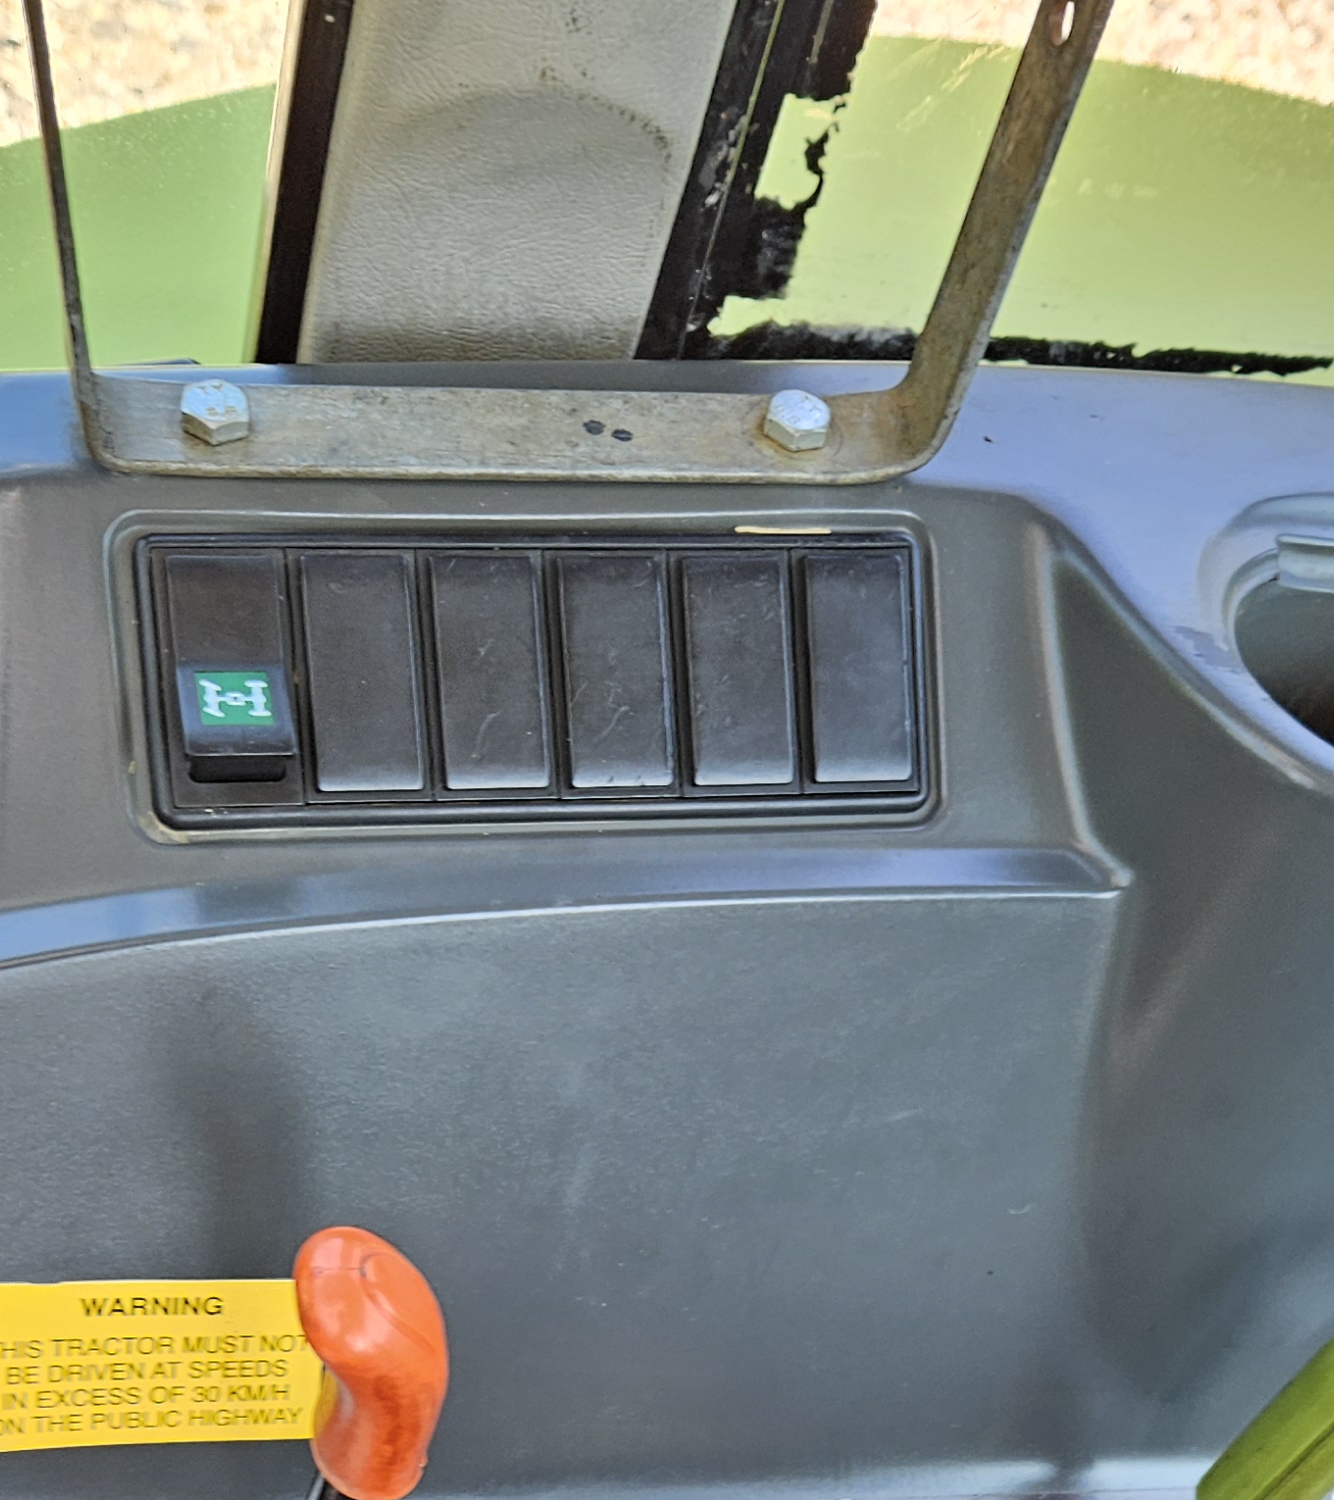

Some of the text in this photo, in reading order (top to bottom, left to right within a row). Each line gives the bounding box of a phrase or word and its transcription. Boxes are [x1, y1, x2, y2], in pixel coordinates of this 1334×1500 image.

[80, 1296, 224, 1317] WARNING
[50, 1336, 174, 1358] TRACTOR
[183, 1335, 255, 1354] MUST
[260, 1334, 308, 1353] NOT
[6, 1359, 289, 1385] BE DRIVEN AT SPEEDS
[1, 1392, 28, 1411] IN
[36, 1387, 142, 1409] EXCESS
[149, 1385, 186, 1404] OF
[190, 1385, 221, 1403] 30
[31, 1413, 84, 1434] THE
[90, 1410, 182, 1431] PUBLIC
[187, 1407, 304, 1427] HIGHWAY
